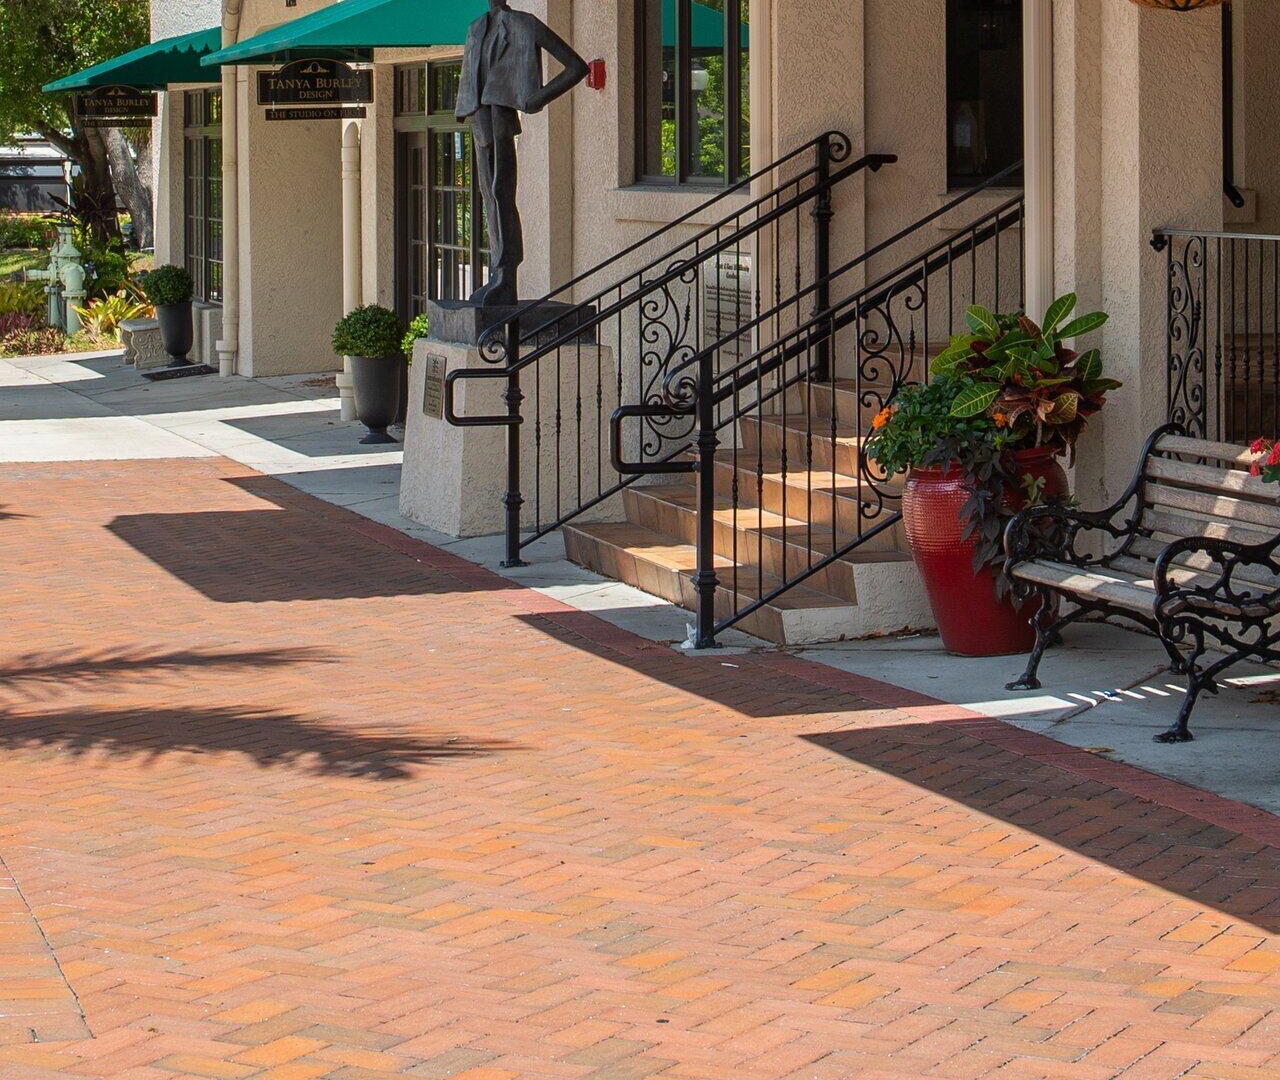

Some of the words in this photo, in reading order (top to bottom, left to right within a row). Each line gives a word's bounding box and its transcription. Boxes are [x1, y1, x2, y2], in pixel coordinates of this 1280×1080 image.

[267, 78, 311, 90] TANYA
[316, 78, 361, 89] BURLEY
[299, 90, 333, 99] DESIGN
[83, 98, 113, 107] TANYA
[117, 98, 149, 107] BURLEY
[270, 110, 286, 119] THE
[289, 110, 321, 118] STUDIO
[323, 109, 337, 118] ON
